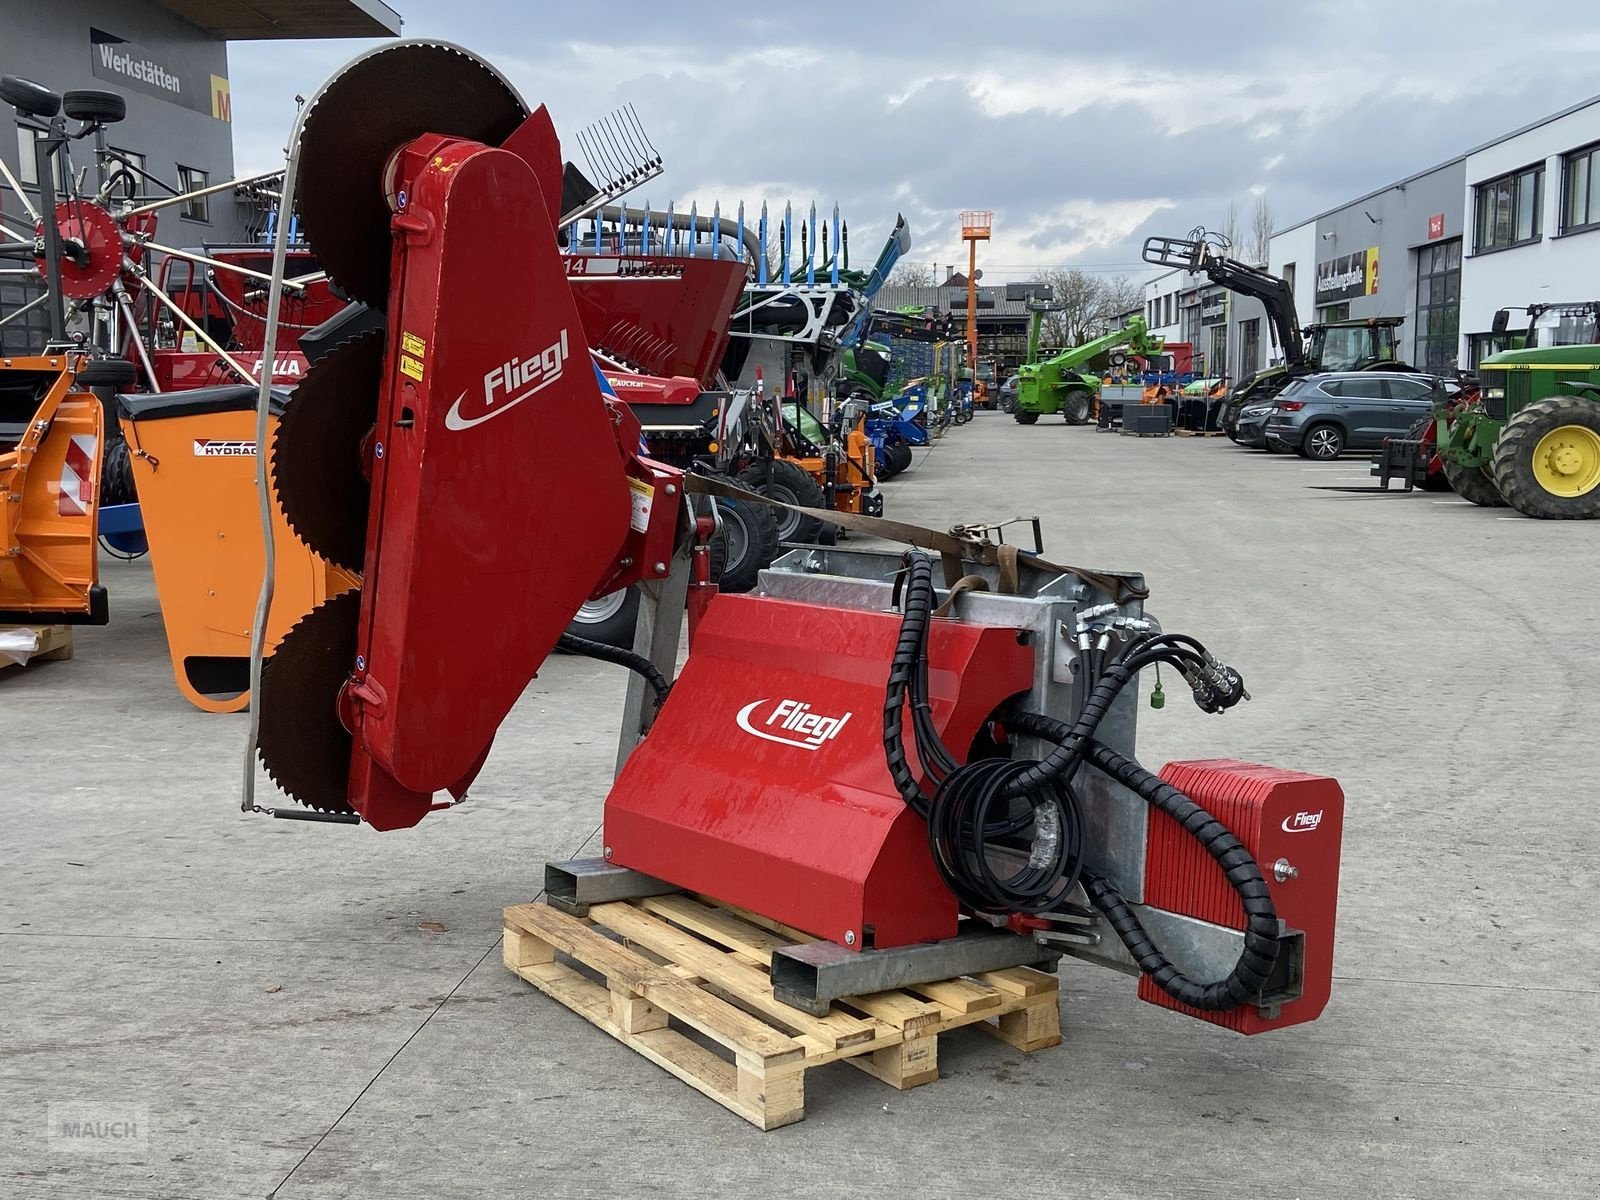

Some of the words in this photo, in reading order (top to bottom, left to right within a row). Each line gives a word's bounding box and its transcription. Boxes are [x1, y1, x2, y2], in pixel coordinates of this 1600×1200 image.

[100, 44, 180, 93] Werkstätten
[252, 360, 300, 375] FLLA
[484, 328, 569, 406] Fliegl
[765, 699, 853, 746] Fliegl
[1293, 809, 1323, 828] Fliegl
